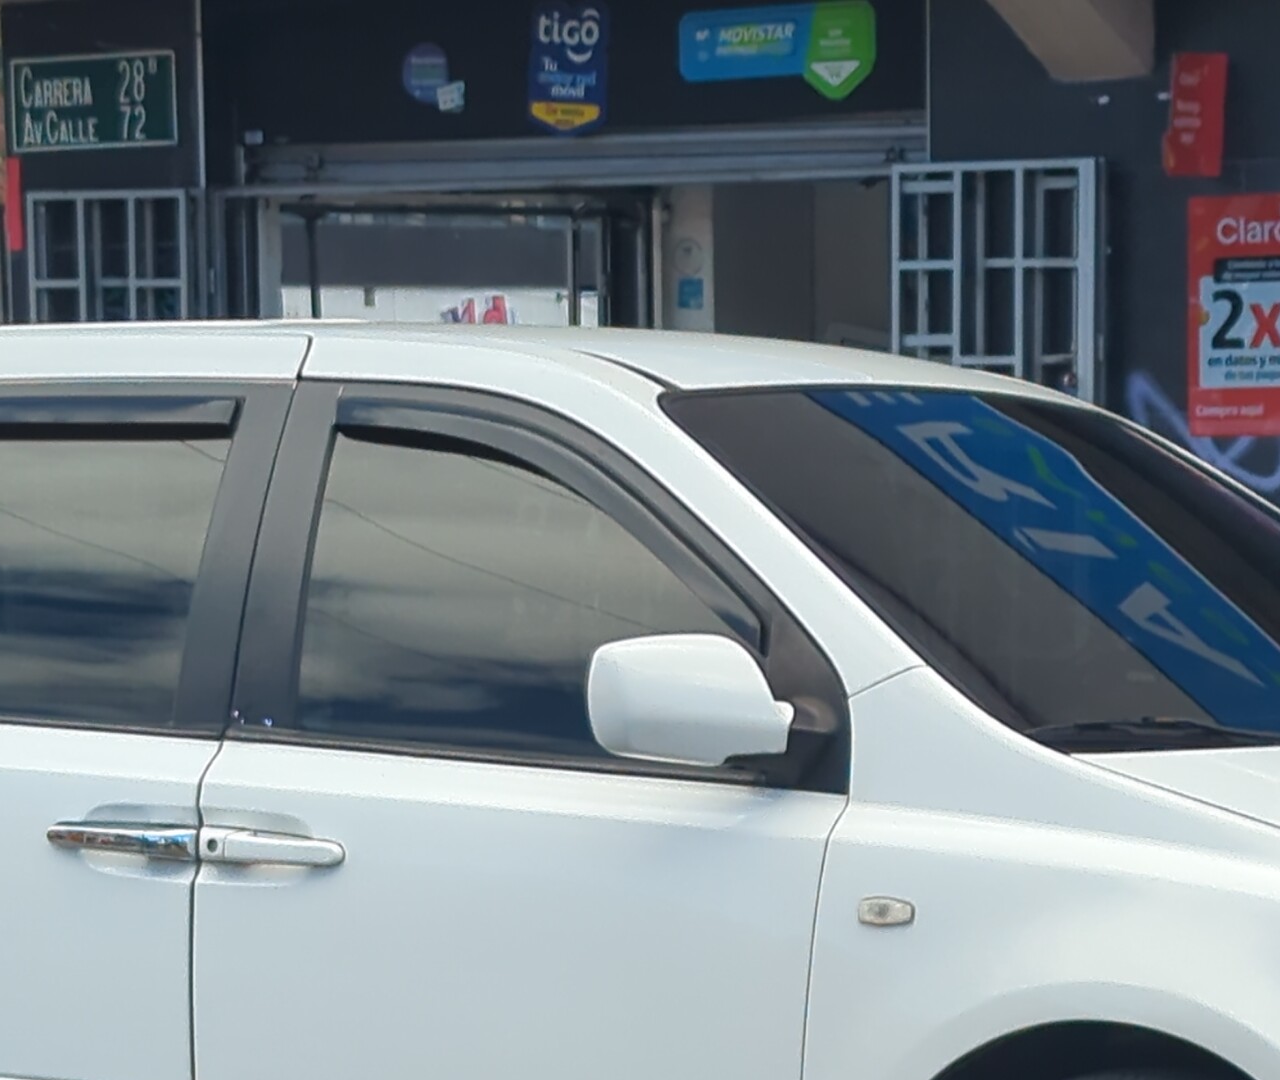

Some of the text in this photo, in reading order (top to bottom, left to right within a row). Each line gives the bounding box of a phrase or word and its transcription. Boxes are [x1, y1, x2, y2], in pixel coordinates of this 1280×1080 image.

[719, 22, 796, 42] MOVISTAR
[20, 66, 93, 108] CARRERA
[45, 110, 100, 144] CALLE
[120, 105, 147, 140] 72
[1207, 357, 1223, 367] en
